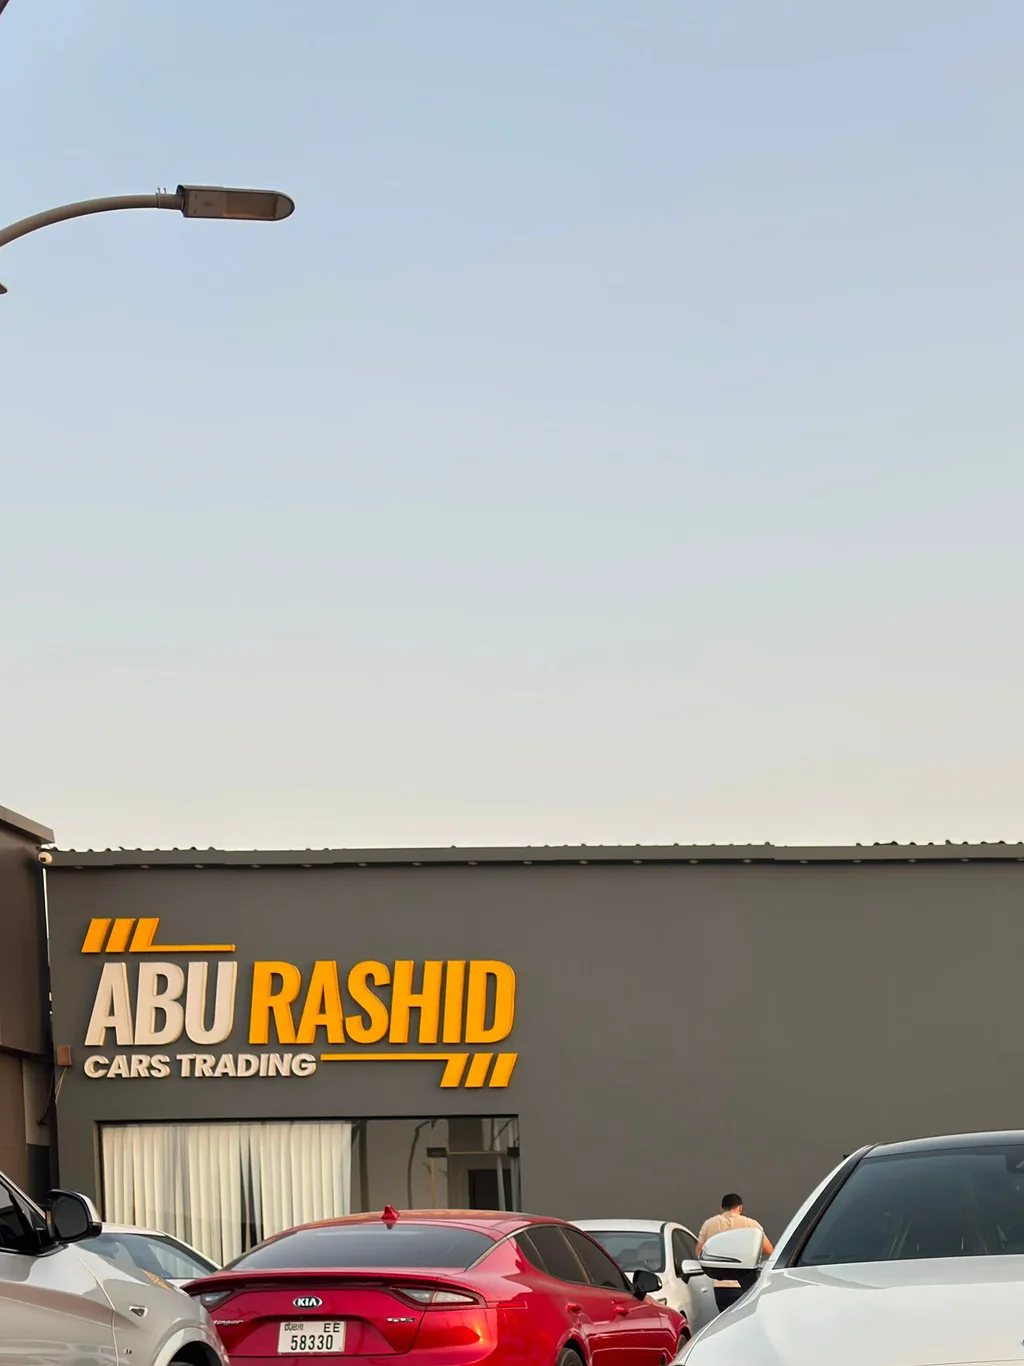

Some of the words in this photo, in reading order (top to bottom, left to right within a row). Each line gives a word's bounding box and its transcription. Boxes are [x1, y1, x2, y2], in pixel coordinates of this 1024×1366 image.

[84, 960, 238, 1046] ABU
[248, 959, 517, 1045] RASHID
[83, 1053, 171, 1079] CARS
[176, 1052, 317, 1078] TRADING
[297, 1297, 317, 1307] KIA
[323, 1322, 341, 1333] EE
[290, 1334, 334, 1351] 58330
